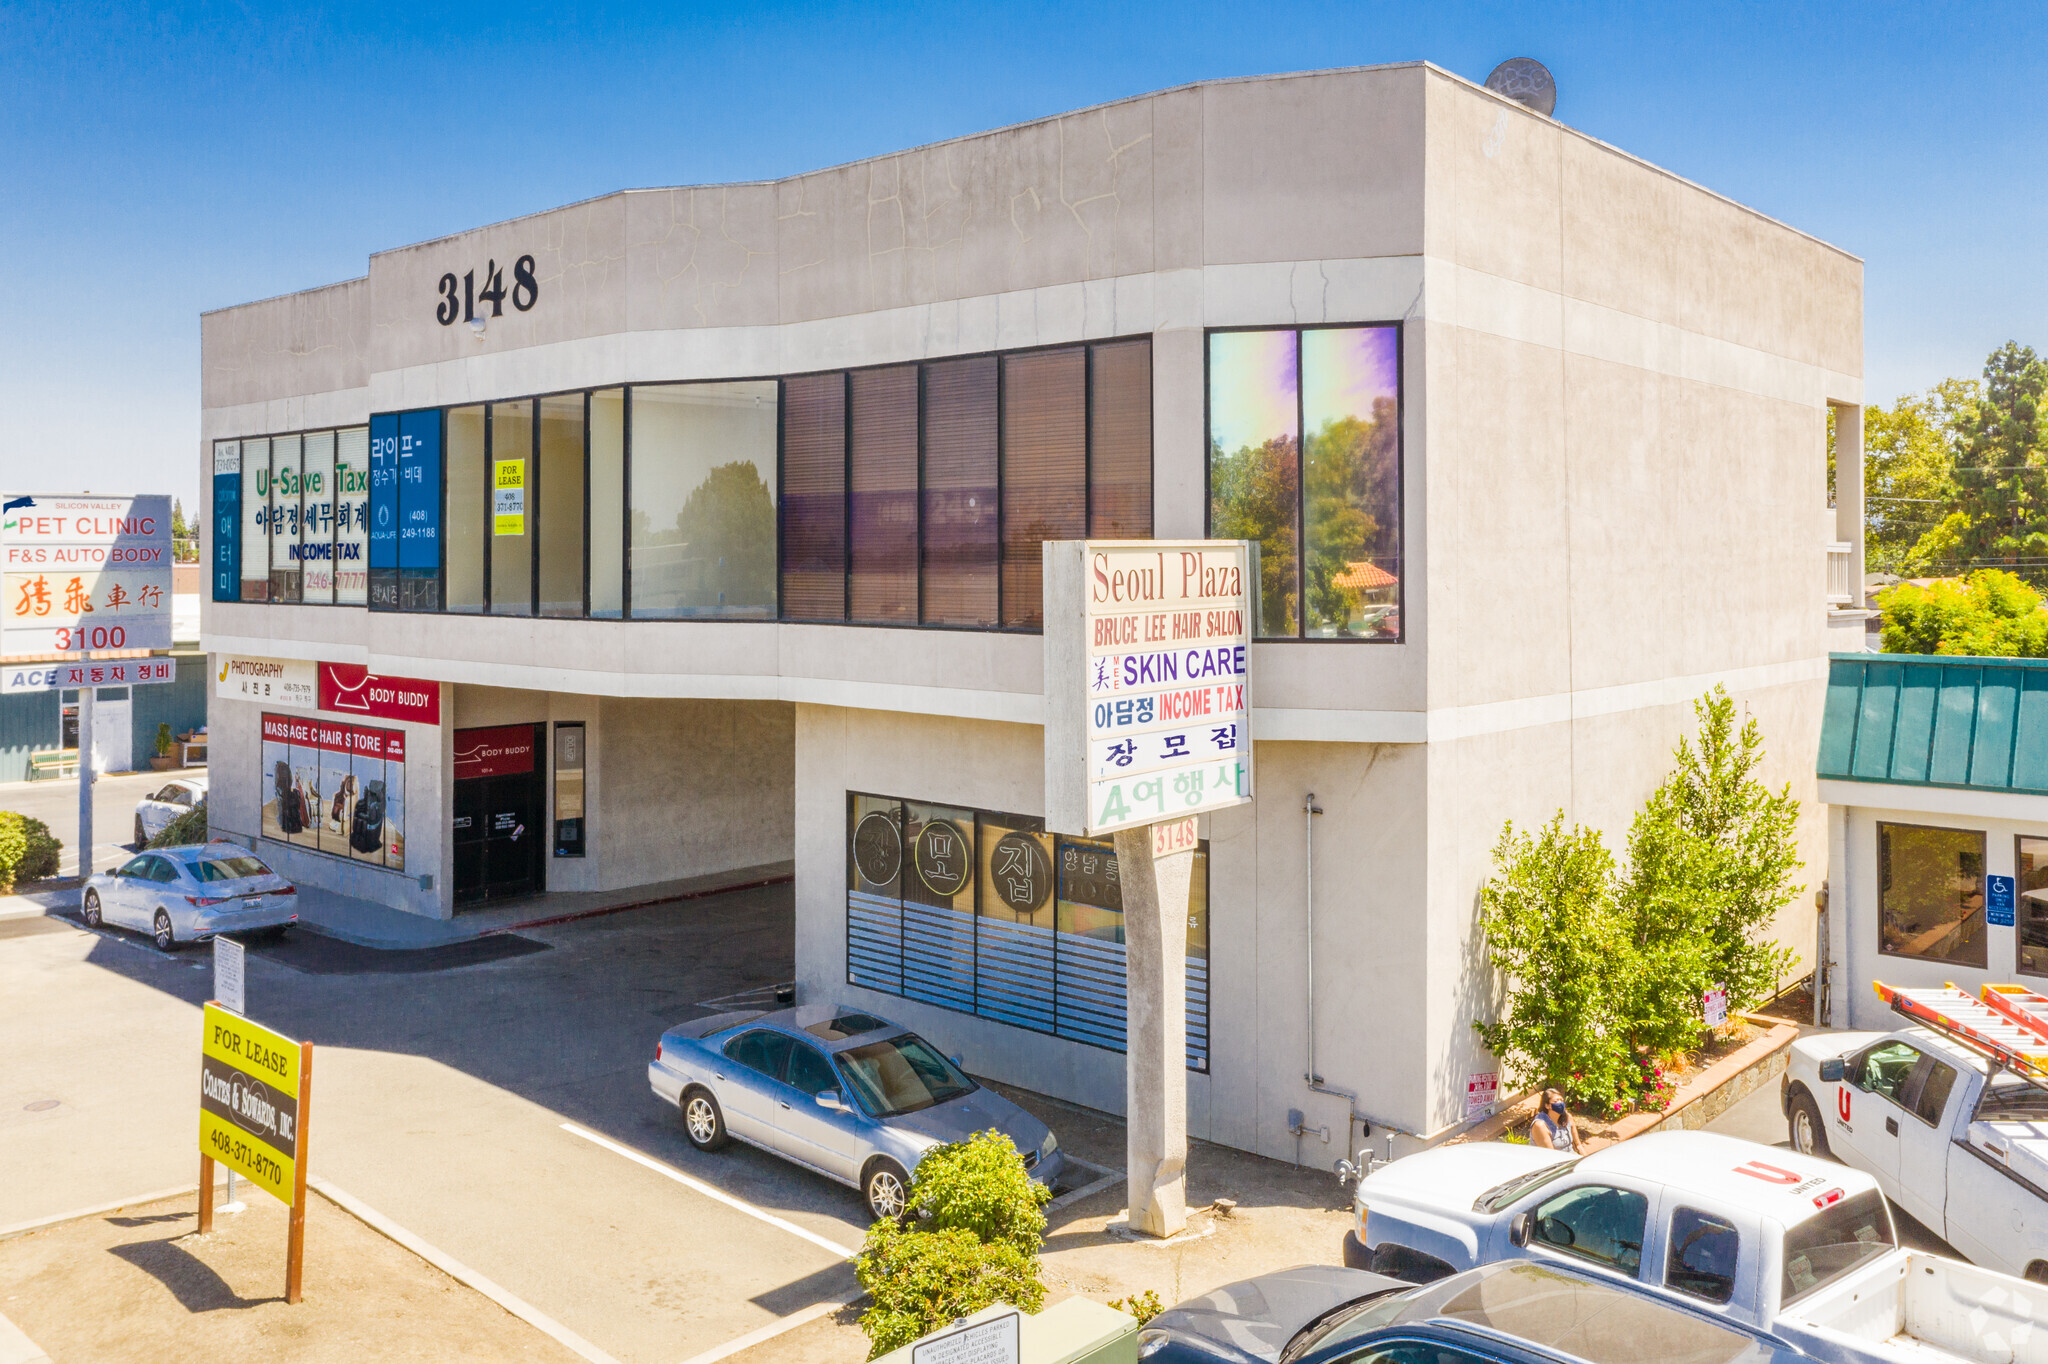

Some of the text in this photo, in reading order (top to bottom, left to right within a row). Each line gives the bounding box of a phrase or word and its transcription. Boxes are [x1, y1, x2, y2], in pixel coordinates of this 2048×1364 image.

[436, 255, 538, 326] 3148
[256, 464, 367, 497] U-Save Tax
[498, 475, 522, 486] LEASE
[502, 465, 517, 475] FOR
[20, 517, 155, 534] PET CLINIC
[402, 528, 435, 538] 249-1188
[9, 548, 162, 562] F&S AUTO BODY
[289, 543, 360, 560] INCOME TAX
[1093, 552, 1242, 603] Seoul Plaza
[55, 626, 126, 650] 3100
[1094, 609, 1243, 647] BRUCE LEE HAIR SALON
[11, 670, 58, 687] ACE
[231, 660, 284, 678] PHOTOGRAPHY
[1123, 646, 1246, 686] SKIN CARE
[370, 688, 429, 708] BODY BUDDY
[1159, 684, 1244, 721] INCOME TAX
[1095, 696, 1154, 728] 아담정
[264, 721, 381, 752] MASSAGE CHAIR STORE
[481, 746, 530, 757] BODY BUDDY
[1156, 818, 1194, 853] 3148
[213, 1024, 288, 1078] FOR LEASE
[232, 1082, 239, 1110] &
[279, 1110, 294, 1142] INC.
[1838, 1085, 1851, 1122] U
[1836, 1117, 1853, 1134] UNITED
[210, 1128, 282, 1186] 408-371-8770
[1789, 1177, 1827, 1195] UNITED
[922, 1337, 962, 1357] UNAUTHORIZED
[989, 1321, 1010, 1333] PARKED
[939, 1343, 970, 1359] DESIGNATED
[971, 1332, 1002, 1347] ACCESSIBLE
[957, 1353, 967, 1362] NOT
[968, 1341, 999, 1357] DISPLAYING
